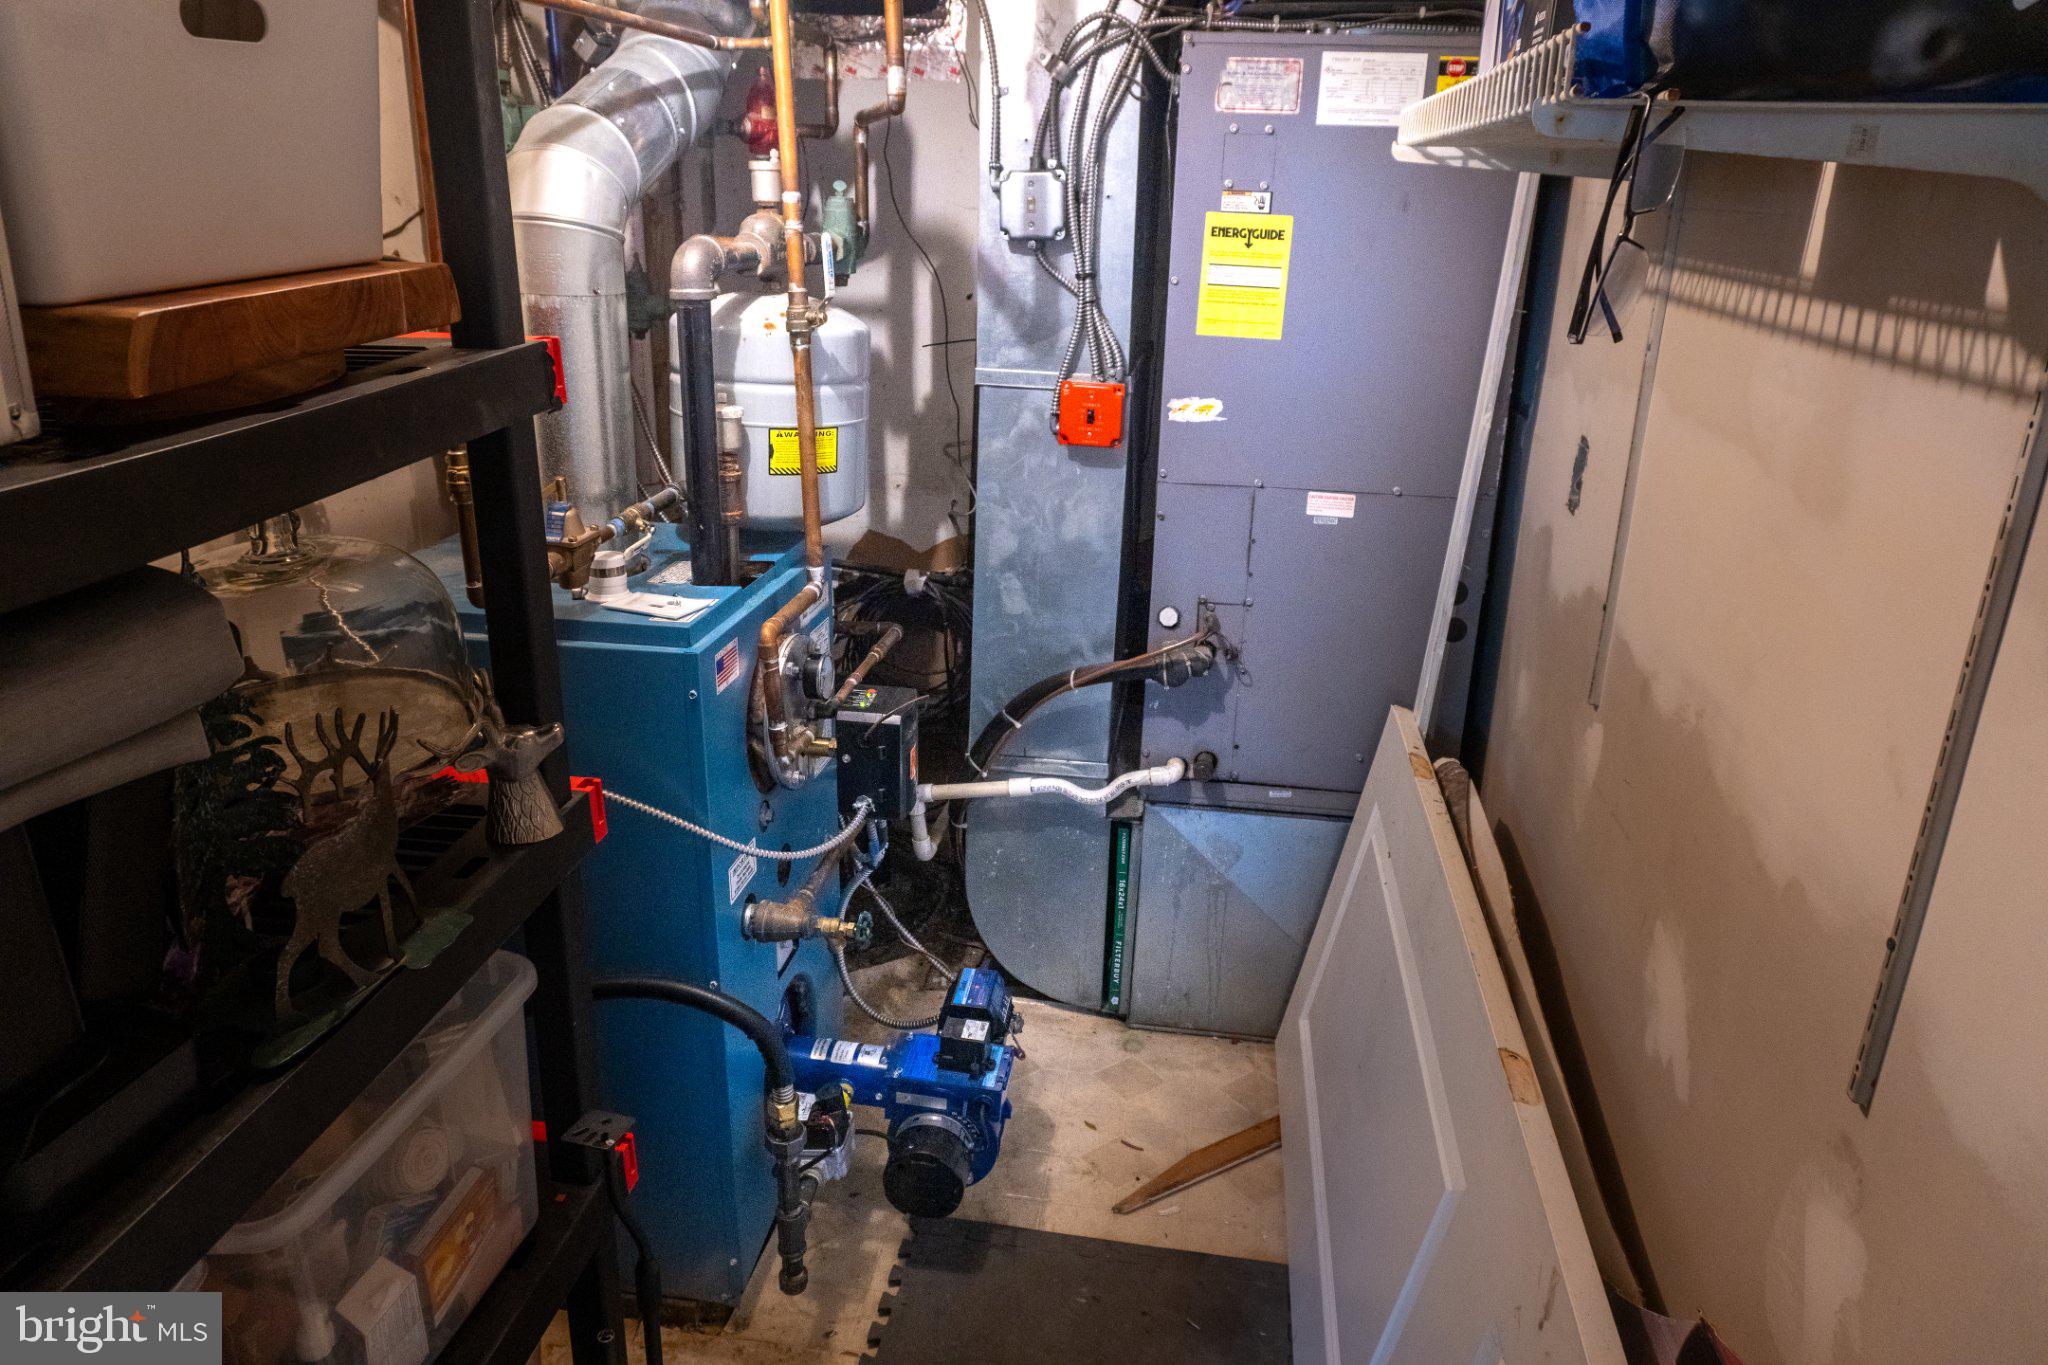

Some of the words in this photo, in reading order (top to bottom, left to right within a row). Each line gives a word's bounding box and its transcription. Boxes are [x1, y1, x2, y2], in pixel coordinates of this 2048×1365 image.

[1449, 64, 1465, 72] STOP
[1211, 226, 1286, 242] ENERGYGUIDE
[1113, 941, 1122, 985] FILTERBUY
